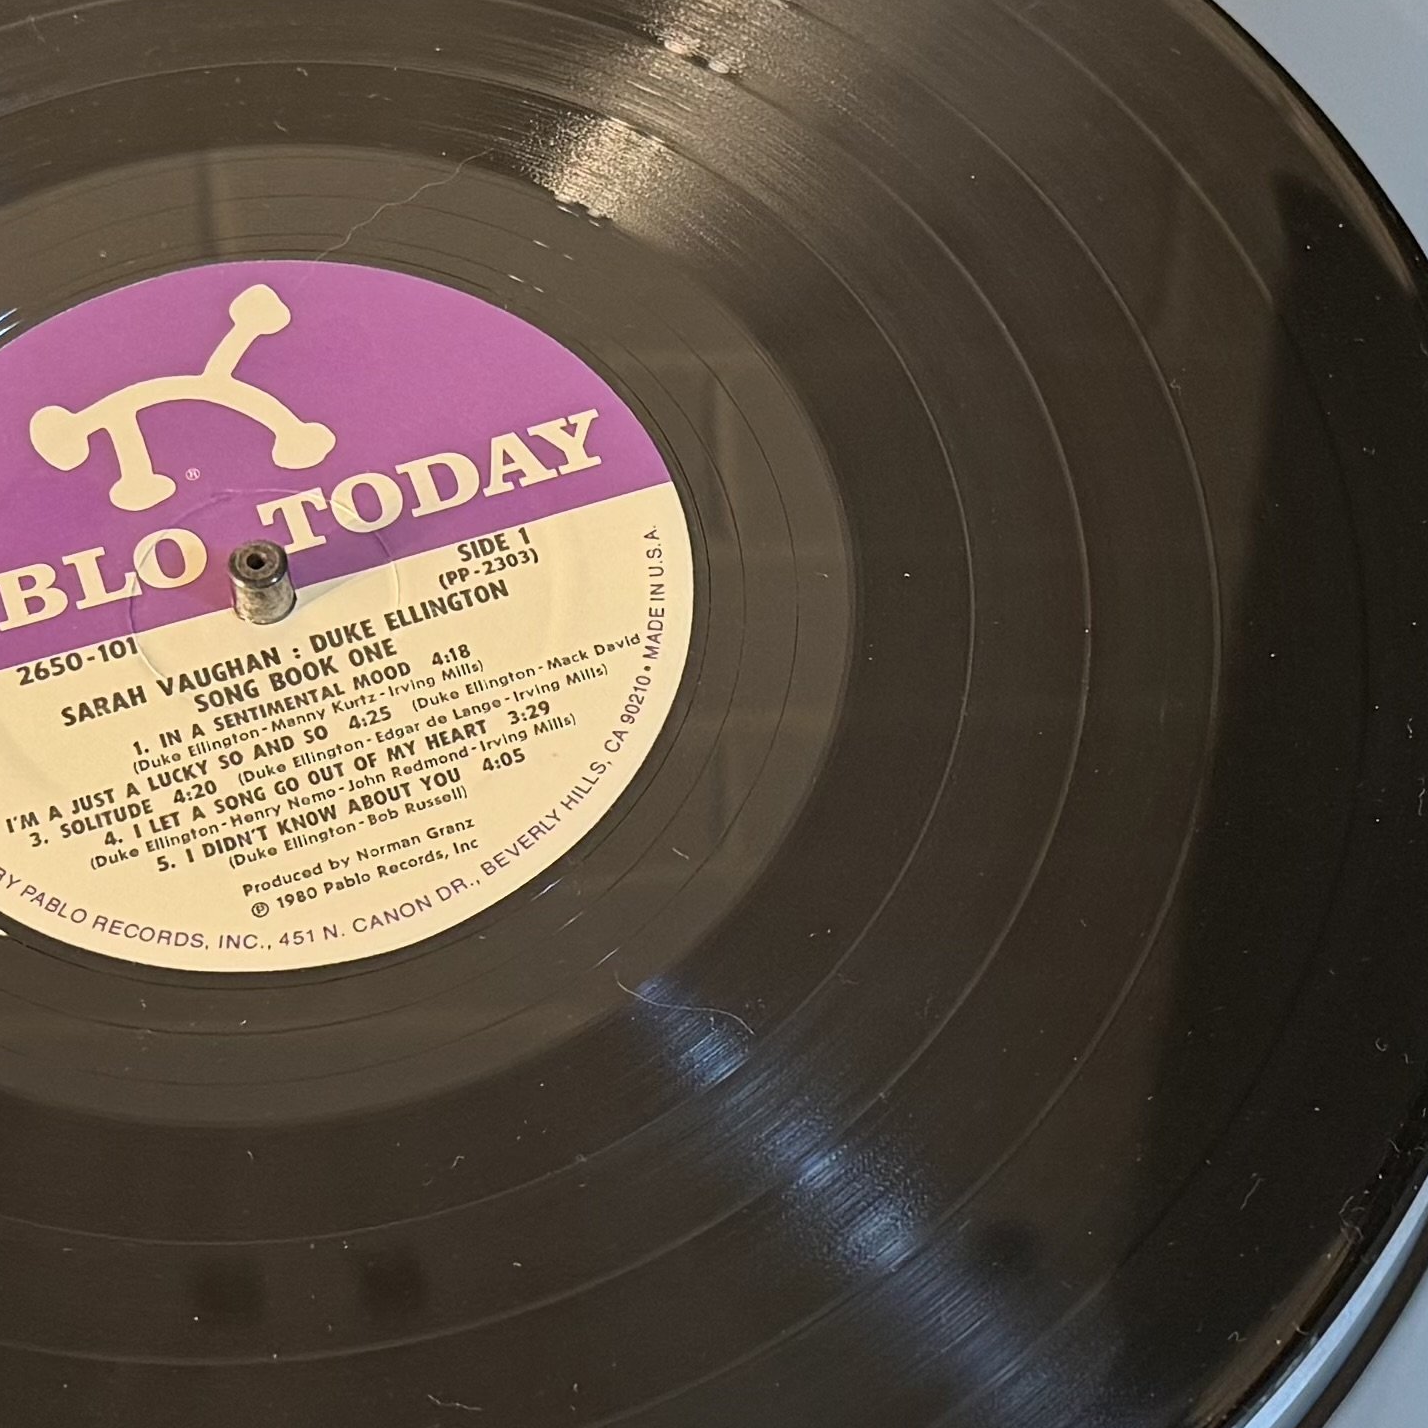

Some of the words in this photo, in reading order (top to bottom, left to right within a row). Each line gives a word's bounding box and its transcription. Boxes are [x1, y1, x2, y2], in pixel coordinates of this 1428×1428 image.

[257, 409, 602, 553] TODAY
[457, 532, 510, 562] SIDE
[518, 526, 530, 545] 1
[643, 525, 665, 577] U.S.A.
[650, 583, 665, 601] IN
[61, 685, 147, 727] SARAH
[155, 646, 281, 696] VAUGHAN
[309, 618, 376, 653] DUKE
[383, 578, 509, 631] ELLINGTON
[642, 607, 665, 660] MADE
[133, 740, 149, 755] 1.
[158, 729, 182, 748] IN
[192, 723, 205, 739] A
[213, 682, 346, 732] SENTIMENTAL
[352, 661, 411, 690] MOOD
[432, 643, 471, 665] 4:18
[193, 678, 260, 713] SONG
[268, 654, 339, 692] BOOK
[348, 637, 397, 667] ONE
[620, 675, 652, 725] 90210
[49, 805, 63, 821] A
[71, 787, 115, 815] JUST
[126, 782, 141, 798] A
[147, 759, 207, 792] LUCKY
[218, 750, 243, 770] SO
[253, 735, 295, 760] AND
[303, 724, 328, 744] SO
[349, 705, 391, 729] 4:25
[412, 690, 459, 712] (Duke
[593, 633, 640, 656] David
[133, 752, 181, 775] (Duke
[441, 659, 483, 681] Mills)
[604, 728, 629, 753] CA
[29, 831, 48, 847] 3.
[60, 798, 153, 839] SOLITUDE
[173, 779, 217, 803] 4:20
[238, 763, 286, 786] (Duke
[426, 715, 447, 727] de
[565, 663, 608, 686] Mills)
[104, 830, 123, 845] 4.
[133, 823, 142, 838] I
[148, 811, 180, 833] LET
[192, 805, 206, 821] A
[213, 786, 266, 814] SONG
[274, 776, 299, 795] GO
[307, 761, 344, 785] OUT
[353, 751, 377, 771] OF
[386, 739, 415, 762] MY
[424, 719, 486, 750] HEART
[507, 700, 550, 725] 3:29
[560, 760, 613, 811] HILLS,
[90, 848, 139, 870] (Duke
[533, 712, 576, 735] Mills)
[156, 855, 176, 872] 5.
[185, 848, 194, 863] I
[276, 804, 337, 836] KNOW
[348, 781, 411, 815] ABOUT
[419, 767, 461, 791] YOU
[482, 747, 525, 771] 4:05
[229, 846, 277, 869] (Duke
[404, 785, 467, 814] Russell)
[242, 862, 323, 897] Produced
[327, 856, 350, 870] by
[356, 835, 421, 861] Norman
[426, 818, 475, 839] Granz
[480, 808, 561, 876] BEVERLY
[20, 884, 87, 924] PABLO
[276, 886, 317, 908] 1980
[323, 872, 371, 894] Pablo
[376, 849, 449, 878] Records,
[452, 838, 478, 854] Inc
[92, 915, 209, 950] RECORDS,
[279, 929, 315, 948] 451
[323, 924, 346, 941] N.
[352, 894, 433, 934] CANON
